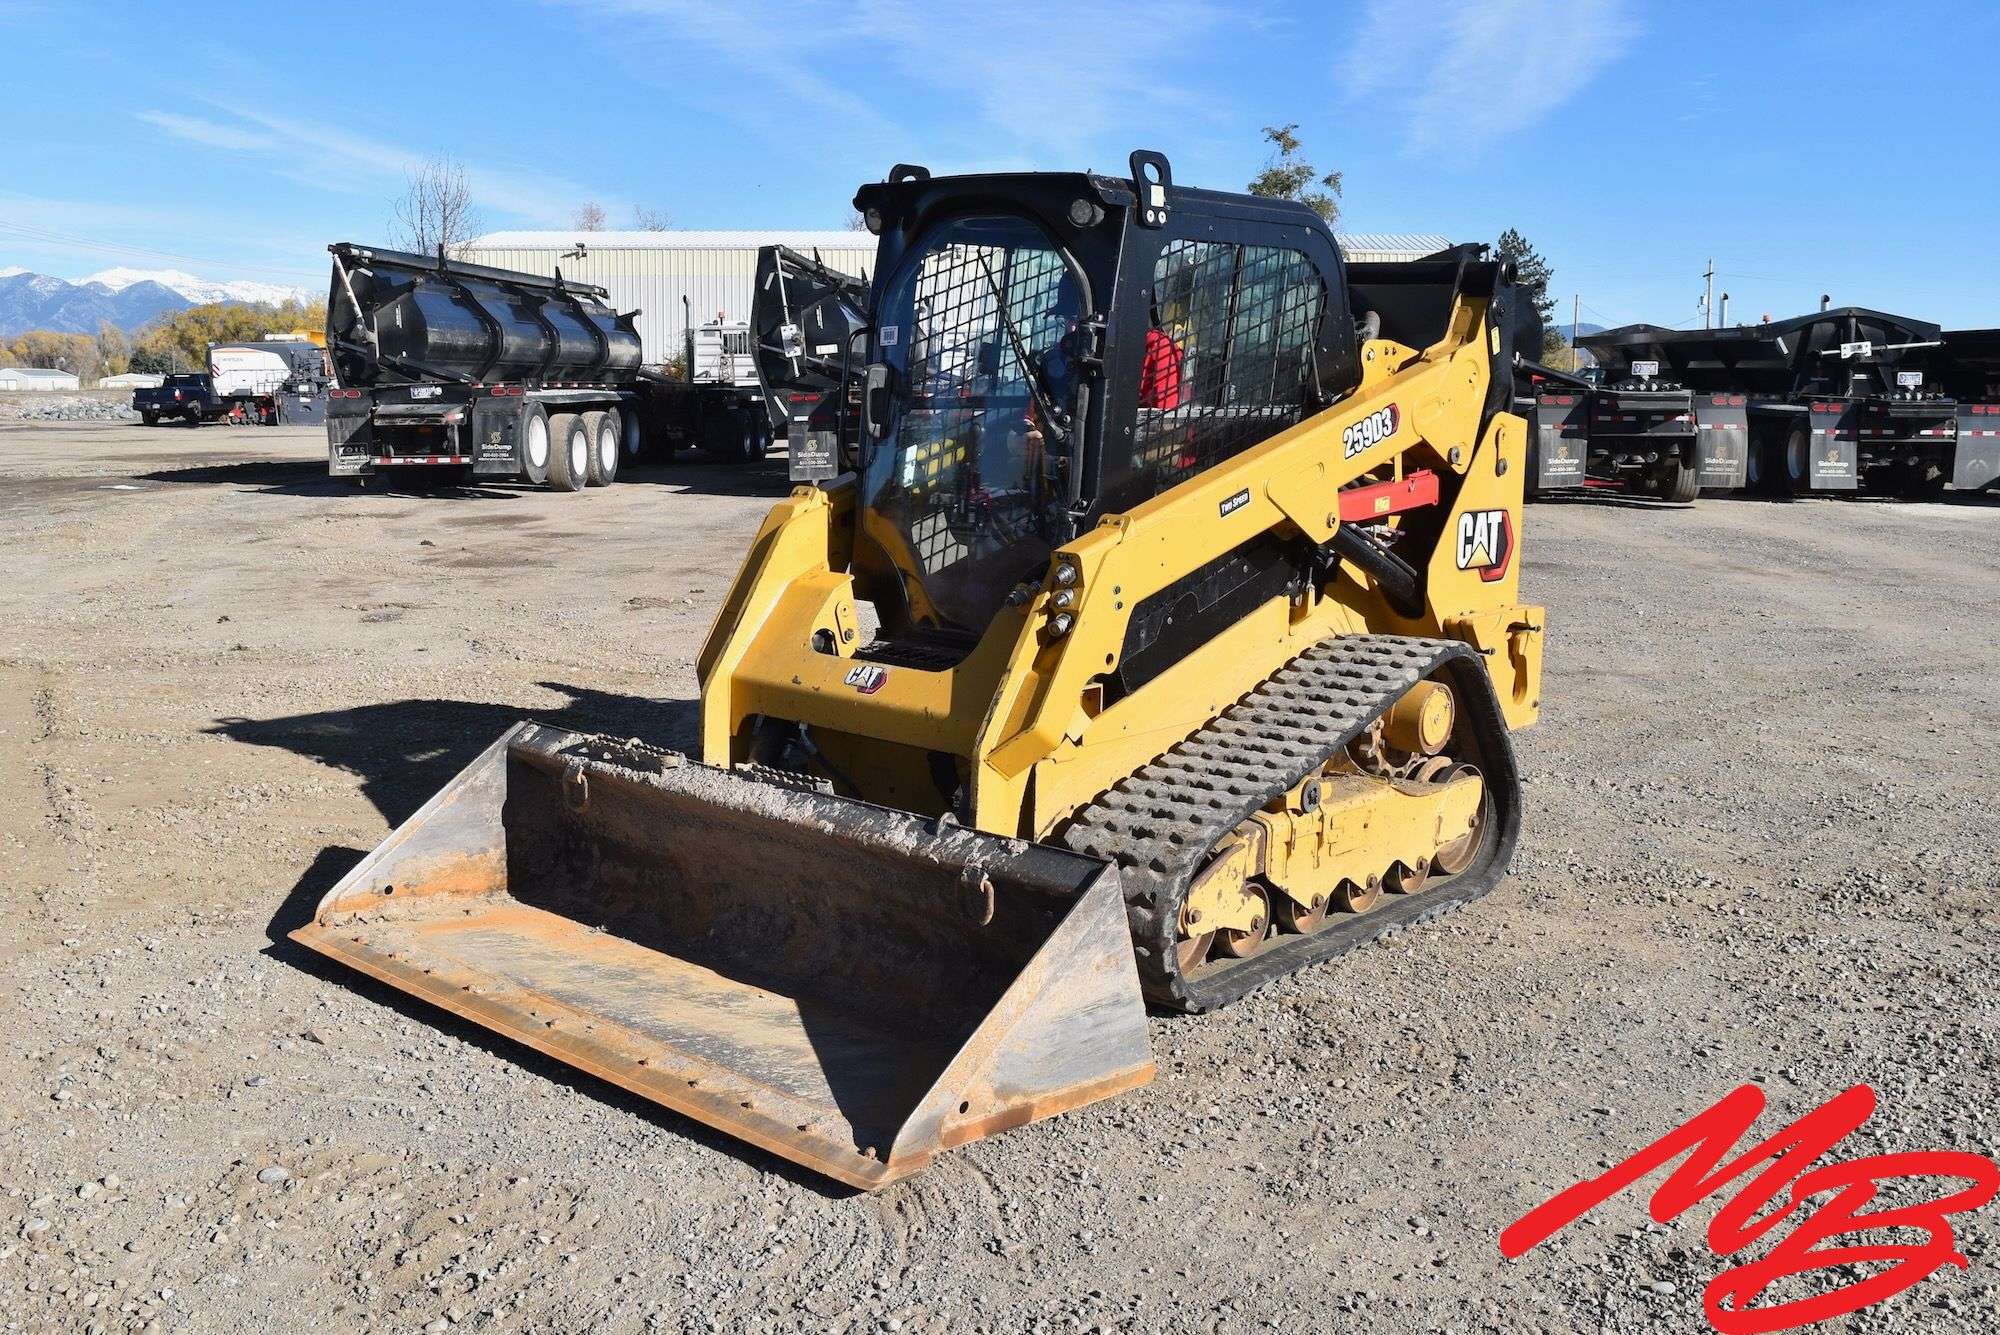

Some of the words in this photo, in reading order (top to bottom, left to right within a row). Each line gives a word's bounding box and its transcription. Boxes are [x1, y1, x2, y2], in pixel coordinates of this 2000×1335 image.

[1343, 407, 1393, 459] 259D3
[1457, 510, 1503, 569] CAT
[845, 665, 883, 688] CAT
